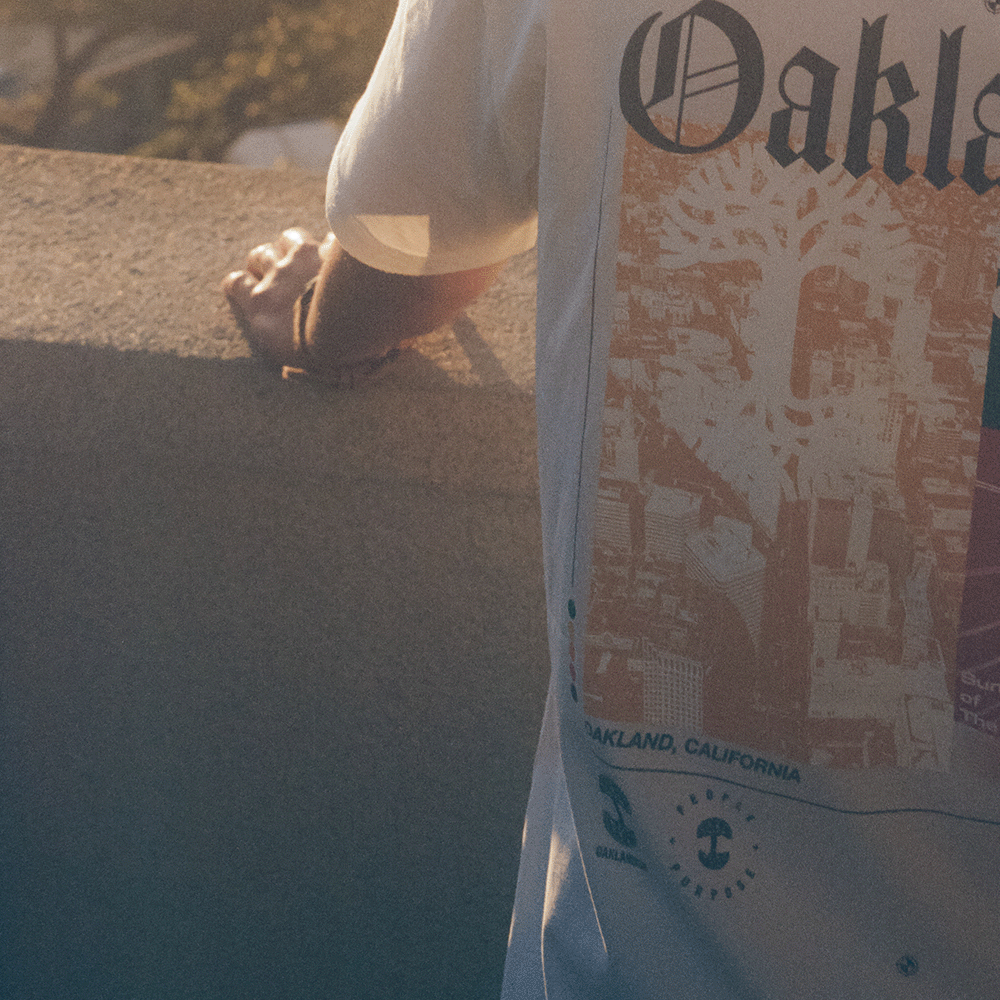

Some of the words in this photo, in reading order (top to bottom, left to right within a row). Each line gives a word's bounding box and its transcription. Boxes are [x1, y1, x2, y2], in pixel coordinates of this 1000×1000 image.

[959, 692, 982, 707] of
[959, 707, 998, 733] The
[684, 738, 802, 784] CALIFORNIA
